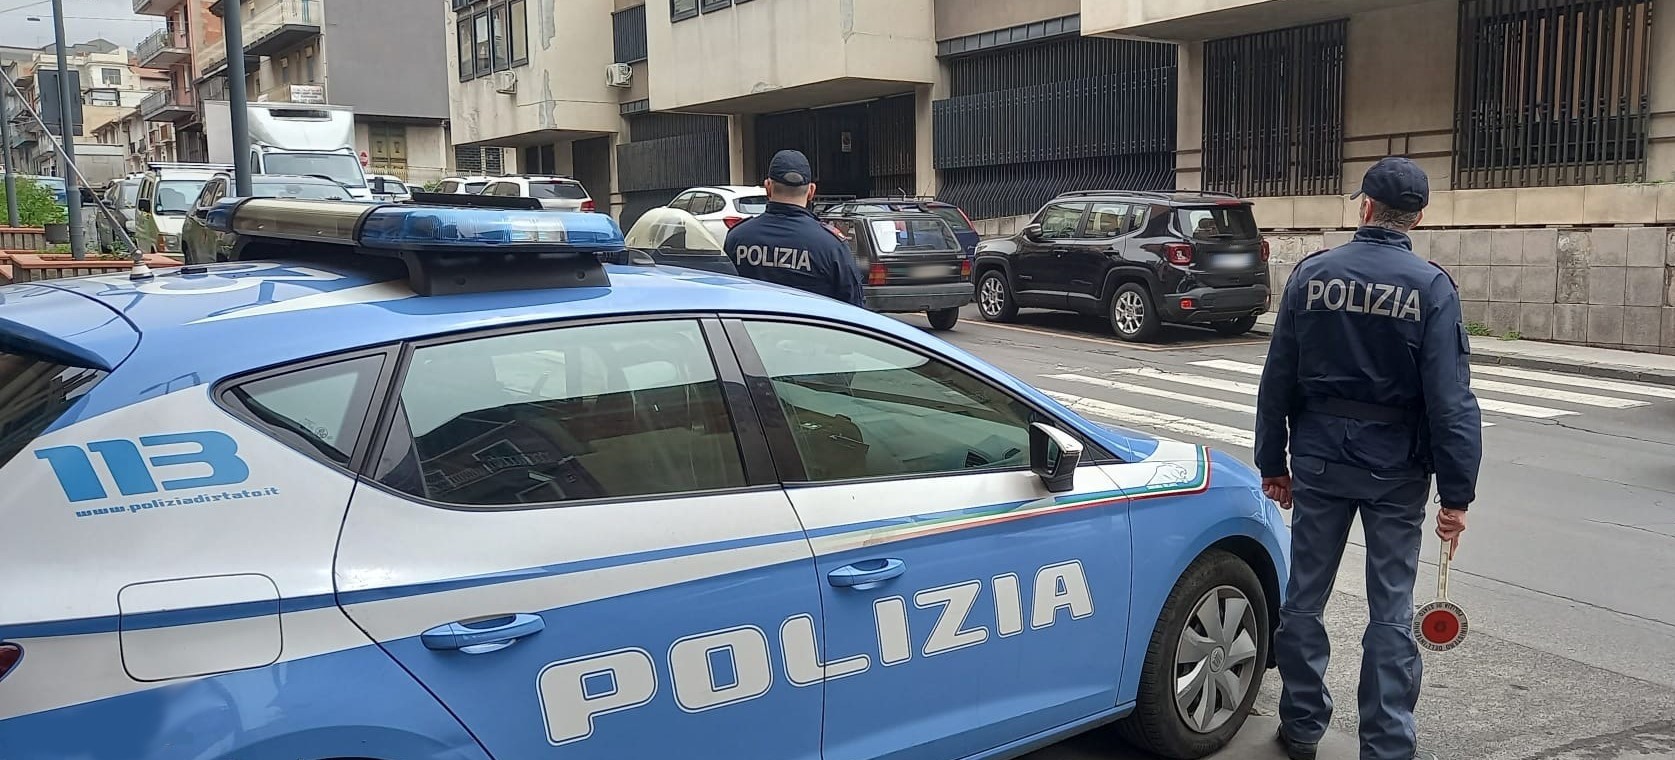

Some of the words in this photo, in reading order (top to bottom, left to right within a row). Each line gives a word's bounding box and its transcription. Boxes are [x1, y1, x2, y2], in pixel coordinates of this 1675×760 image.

[736, 245, 811, 271] POLIZIA
[1306, 279, 1421, 321] POLIZIA
[34, 430, 250, 503] 113
[76, 487, 280, 518] www.poliziadistato.it
[1445, 603, 1463, 616] POLIZIA
[536, 559, 1095, 746] POLIZIA
